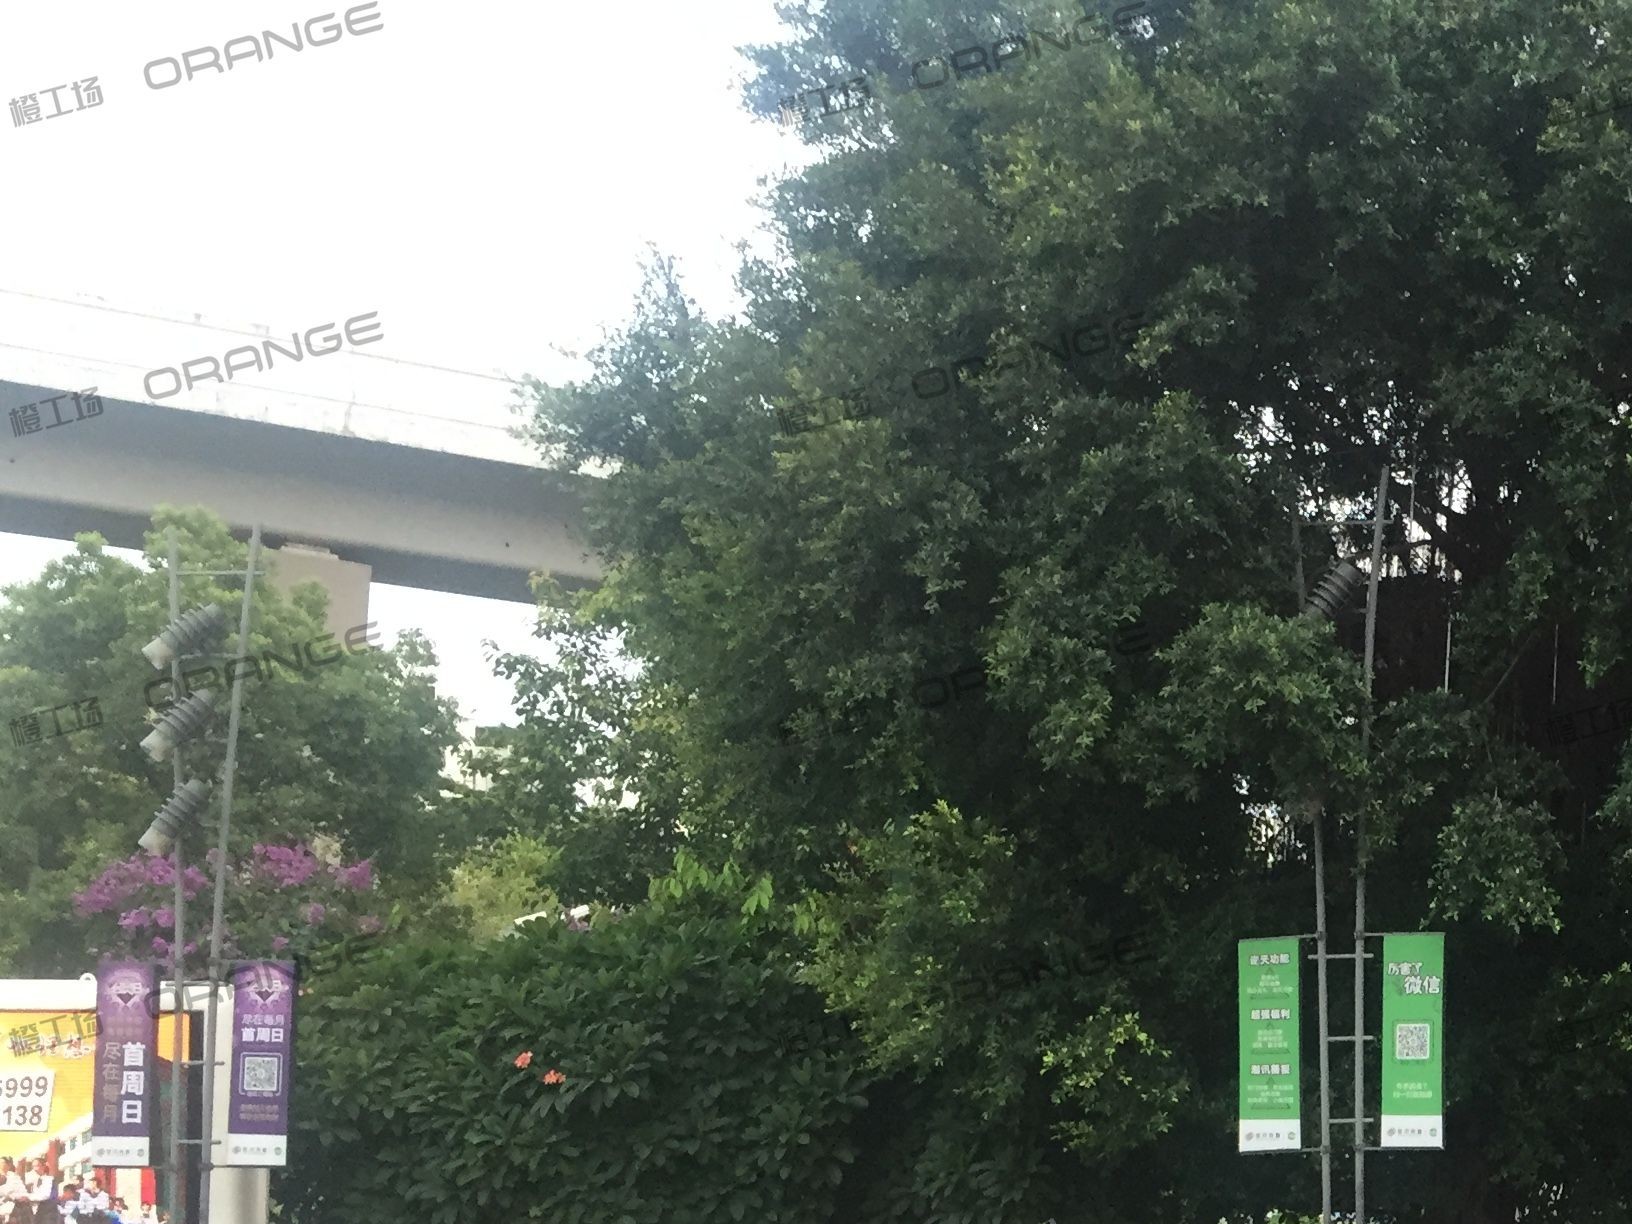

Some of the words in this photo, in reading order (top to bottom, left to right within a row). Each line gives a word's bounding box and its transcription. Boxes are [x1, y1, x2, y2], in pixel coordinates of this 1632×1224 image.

[1404, 975, 1441, 995] 微信
[240, 1027, 285, 1043] 首周日
[0, 1075, 49, 1099] 999
[121, 1041, 146, 1124] 首周日
[2, 1104, 44, 1126] 138
